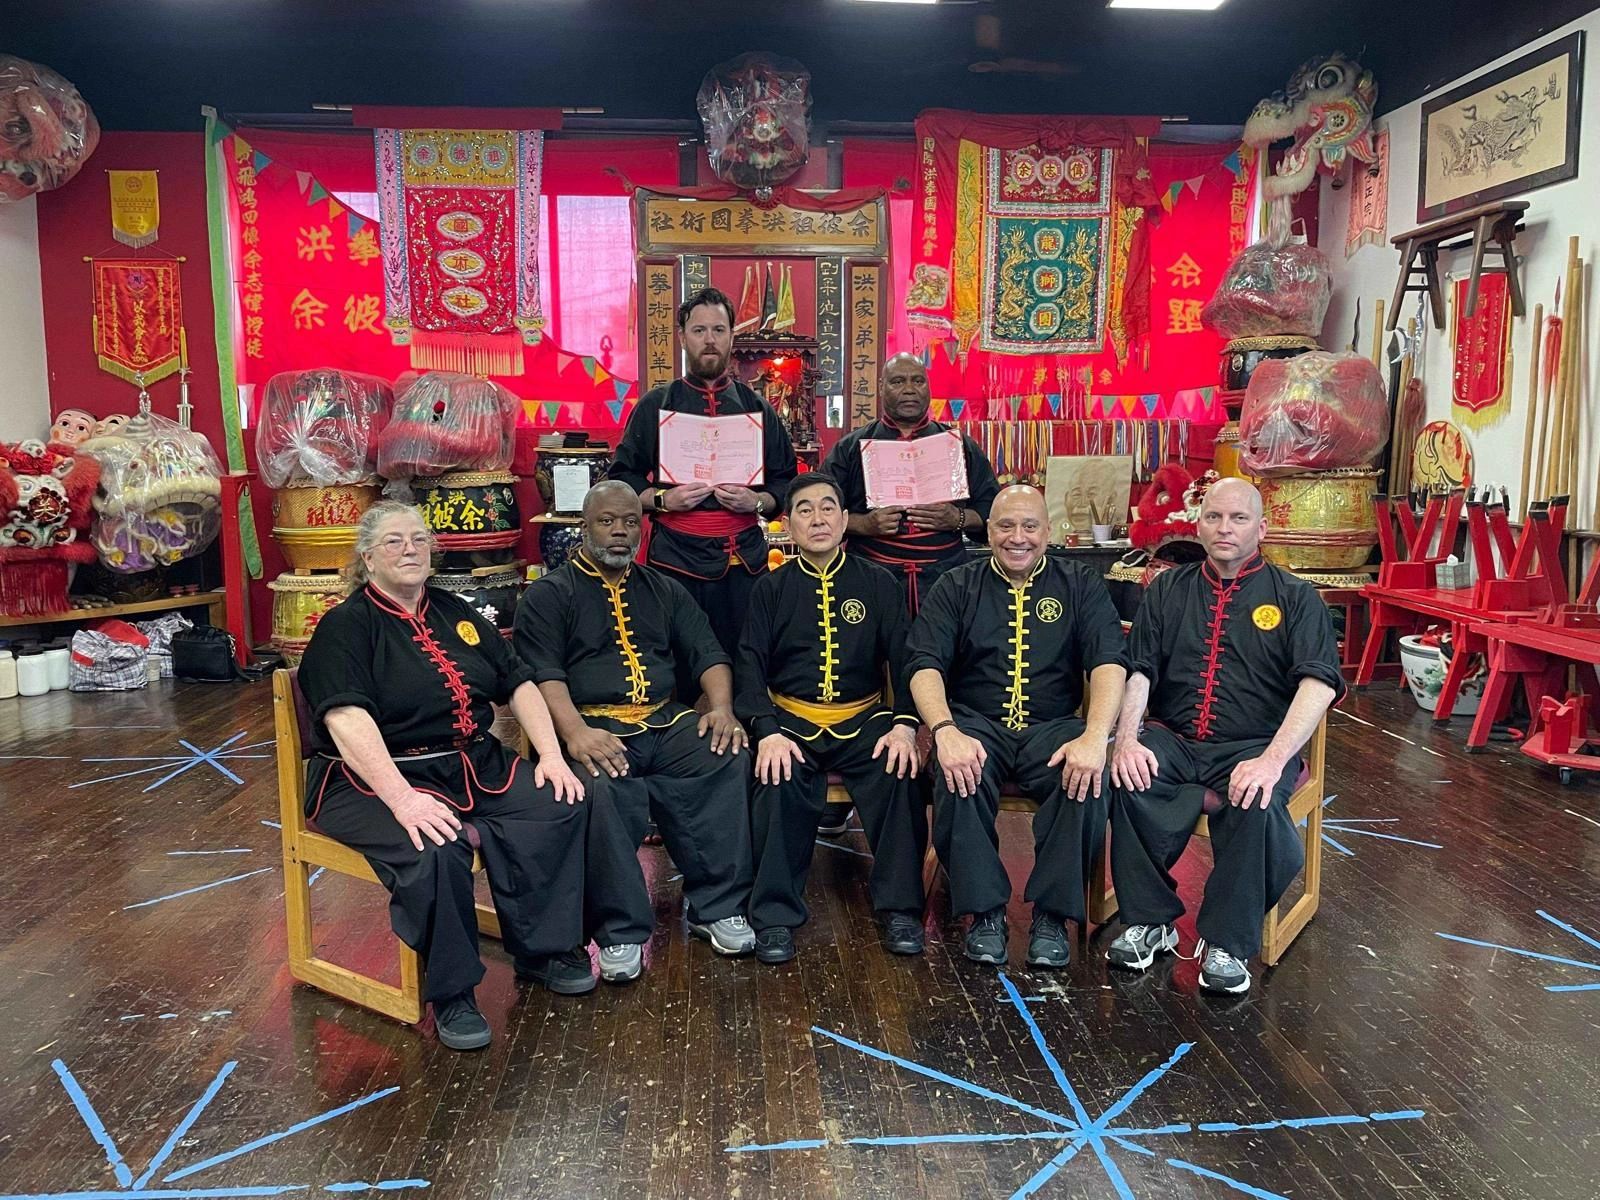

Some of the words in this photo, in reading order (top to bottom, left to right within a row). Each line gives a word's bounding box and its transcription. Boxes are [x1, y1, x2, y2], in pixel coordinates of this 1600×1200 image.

[454, 218, 470, 307] 國術社
[853, 275, 876, 431] 洪家弟子遍天
